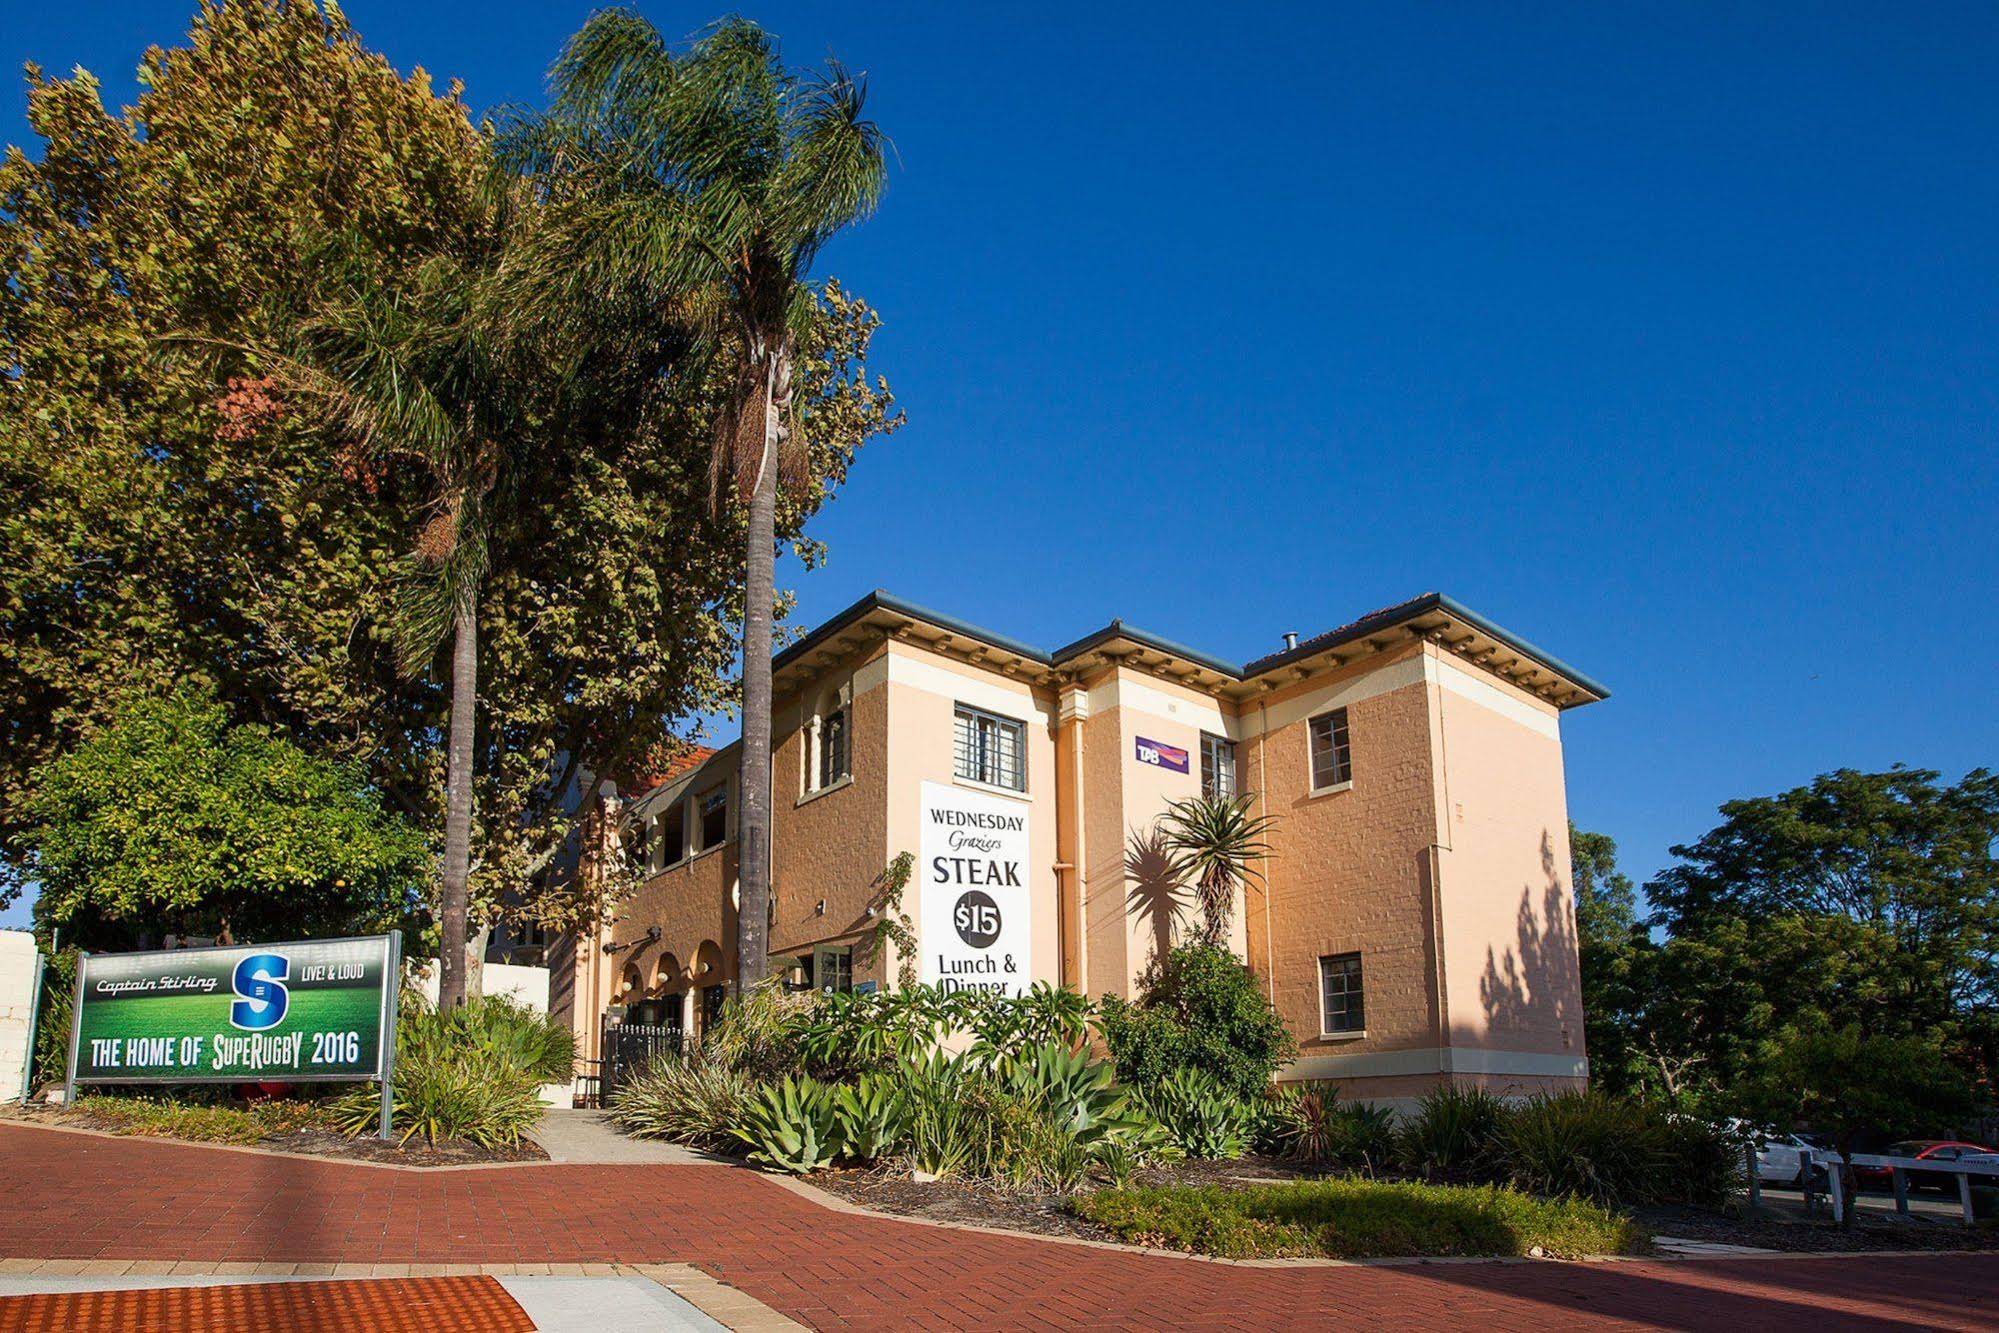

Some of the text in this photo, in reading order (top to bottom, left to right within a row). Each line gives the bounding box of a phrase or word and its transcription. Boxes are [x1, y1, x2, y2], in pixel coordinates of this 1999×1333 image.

[1137, 745, 1160, 765] TAB
[930, 808, 1024, 831] WEDNESDAY
[948, 830, 1002, 852] Graziers
[933, 856, 1021, 887] STEAK
[955, 903, 999, 936] $15
[302, 963, 364, 981] LIVE! & LOUD
[938, 953, 1017, 974] Lunch &
[96, 975, 218, 997] Captain Stirling
[91, 1038, 121, 1067] THE
[125, 1037, 175, 1067] HOME
[180, 1036, 203, 1065] OF
[311, 1031, 360, 1063] 2016
